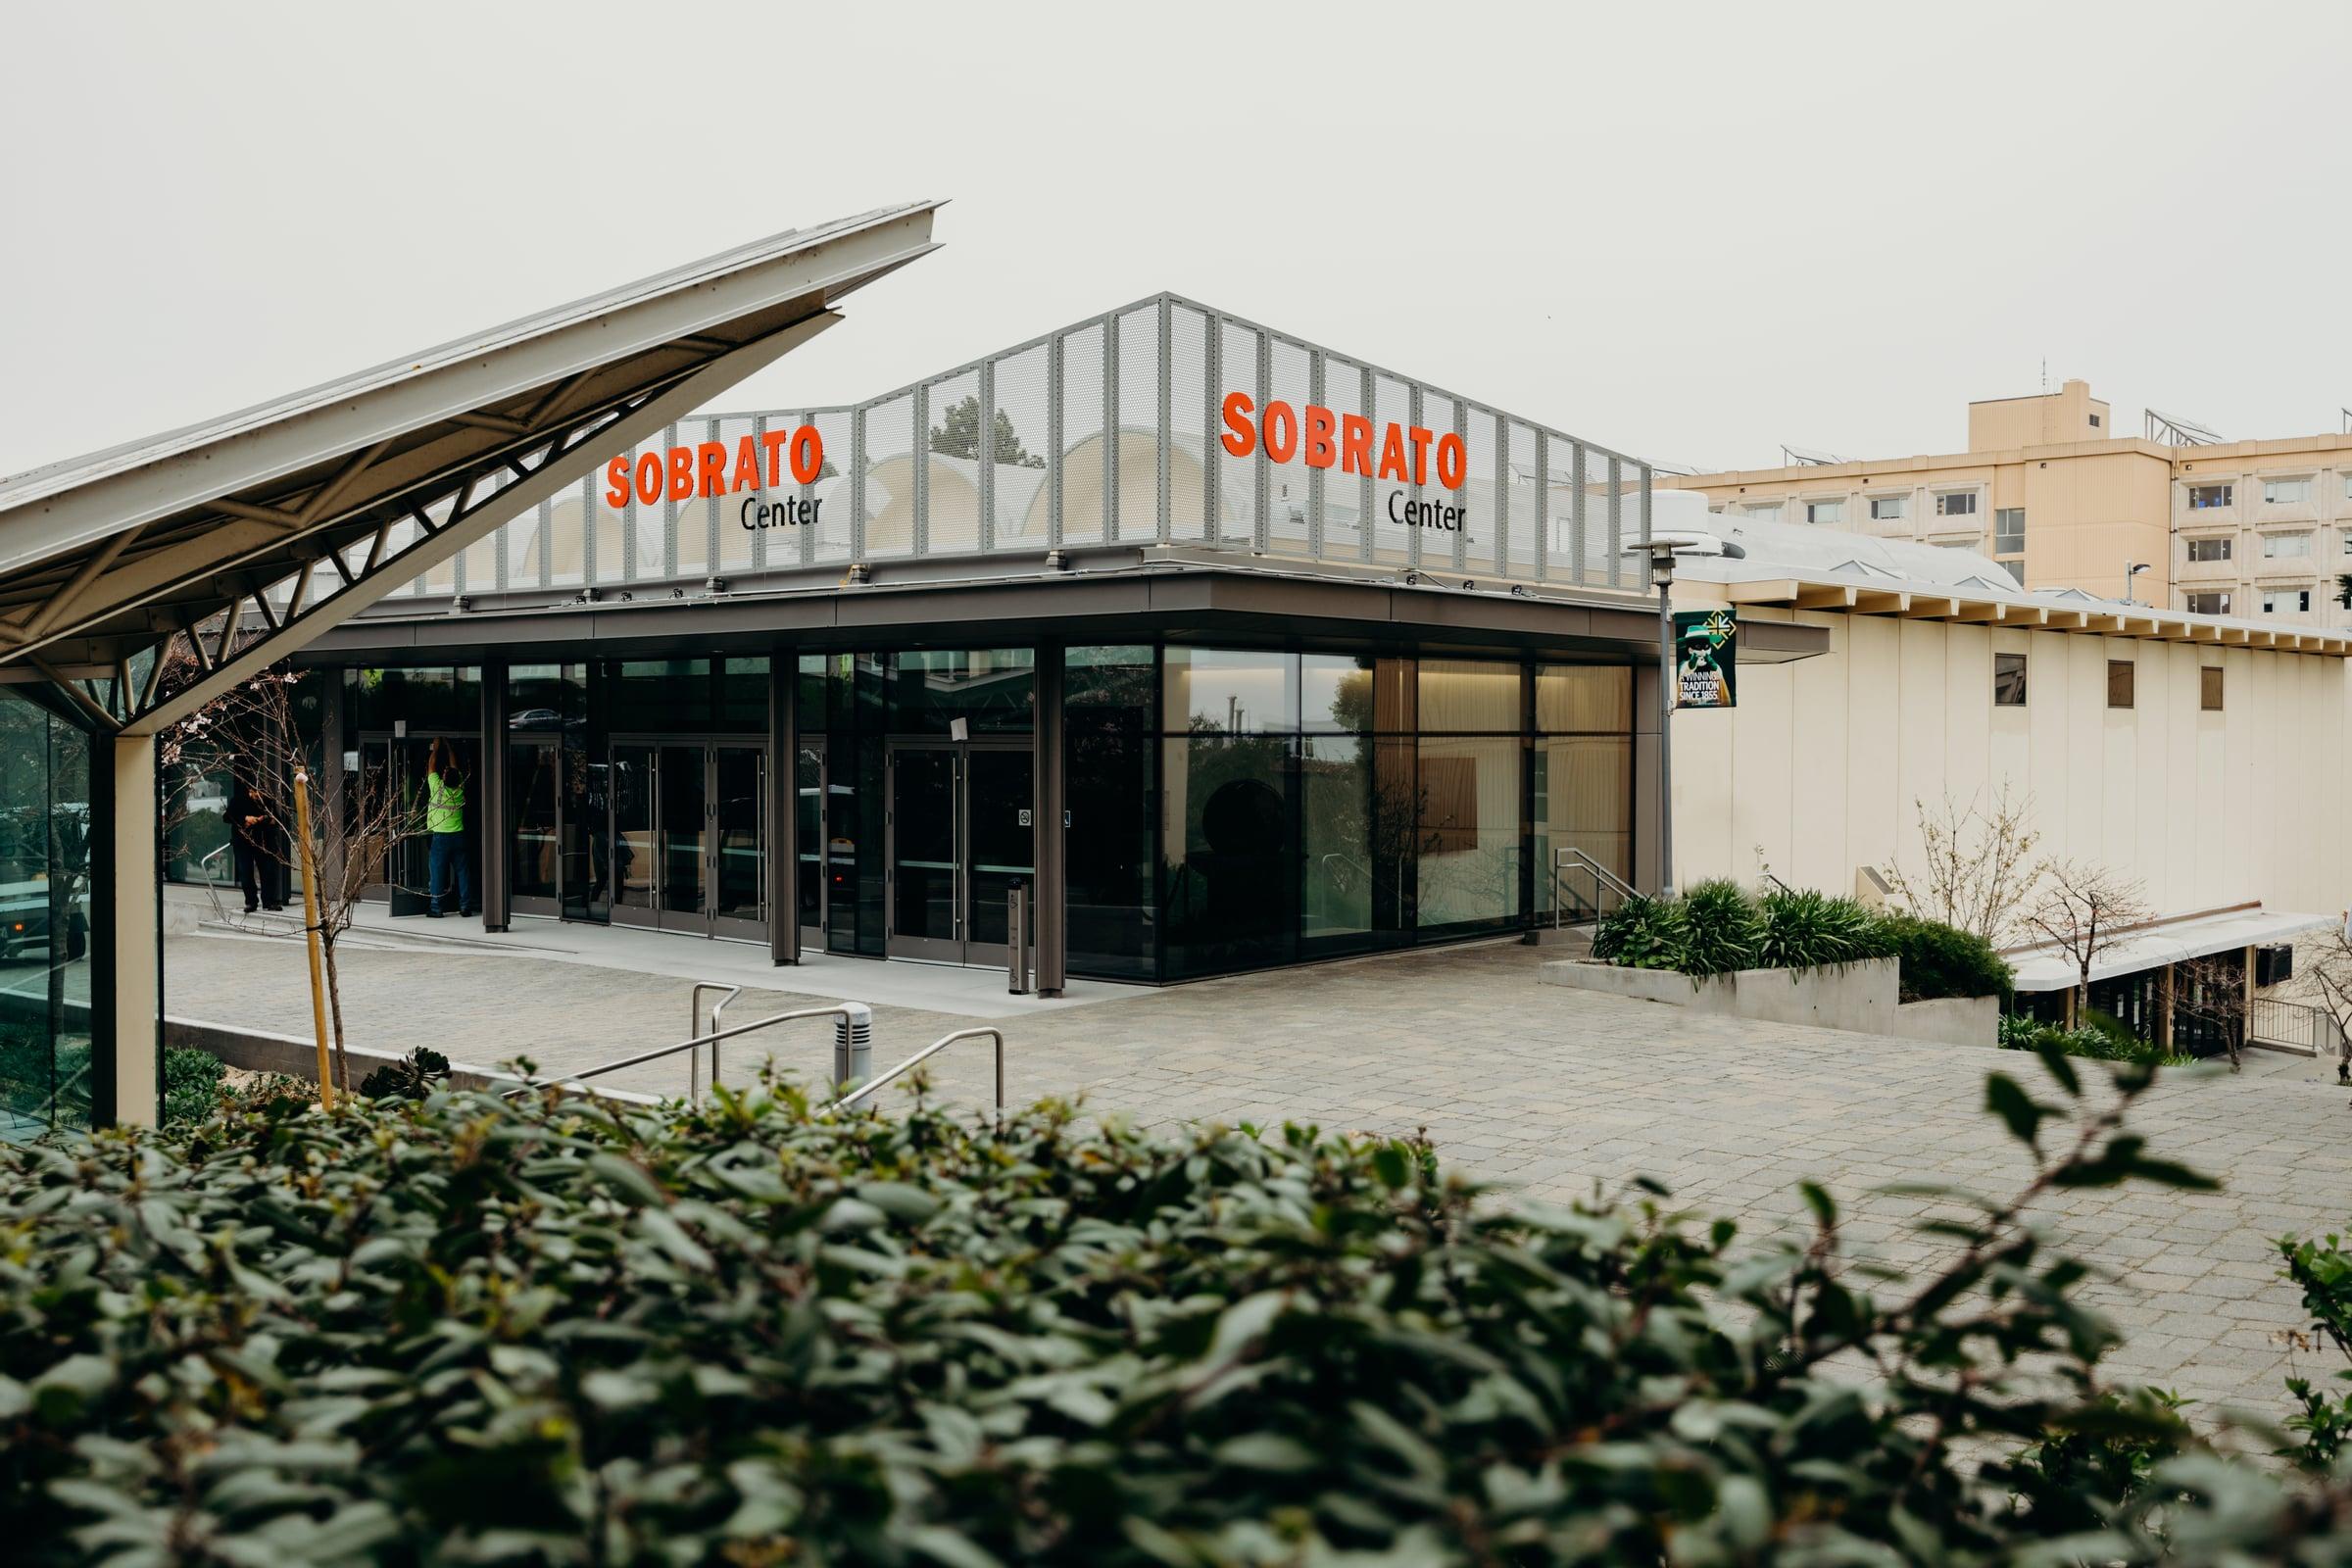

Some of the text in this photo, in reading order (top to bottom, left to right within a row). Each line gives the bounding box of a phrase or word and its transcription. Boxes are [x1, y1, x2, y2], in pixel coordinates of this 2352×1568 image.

[1221, 392, 1467, 489] SOBRATO
[606, 424, 822, 509] SOBRATO
[741, 495, 822, 530] Center
[1388, 490, 1466, 532] Center
[1680, 680, 1720, 691] TRADITION
[1686, 671, 1717, 681] WINNING
[1680, 691, 1700, 701] SINCE
